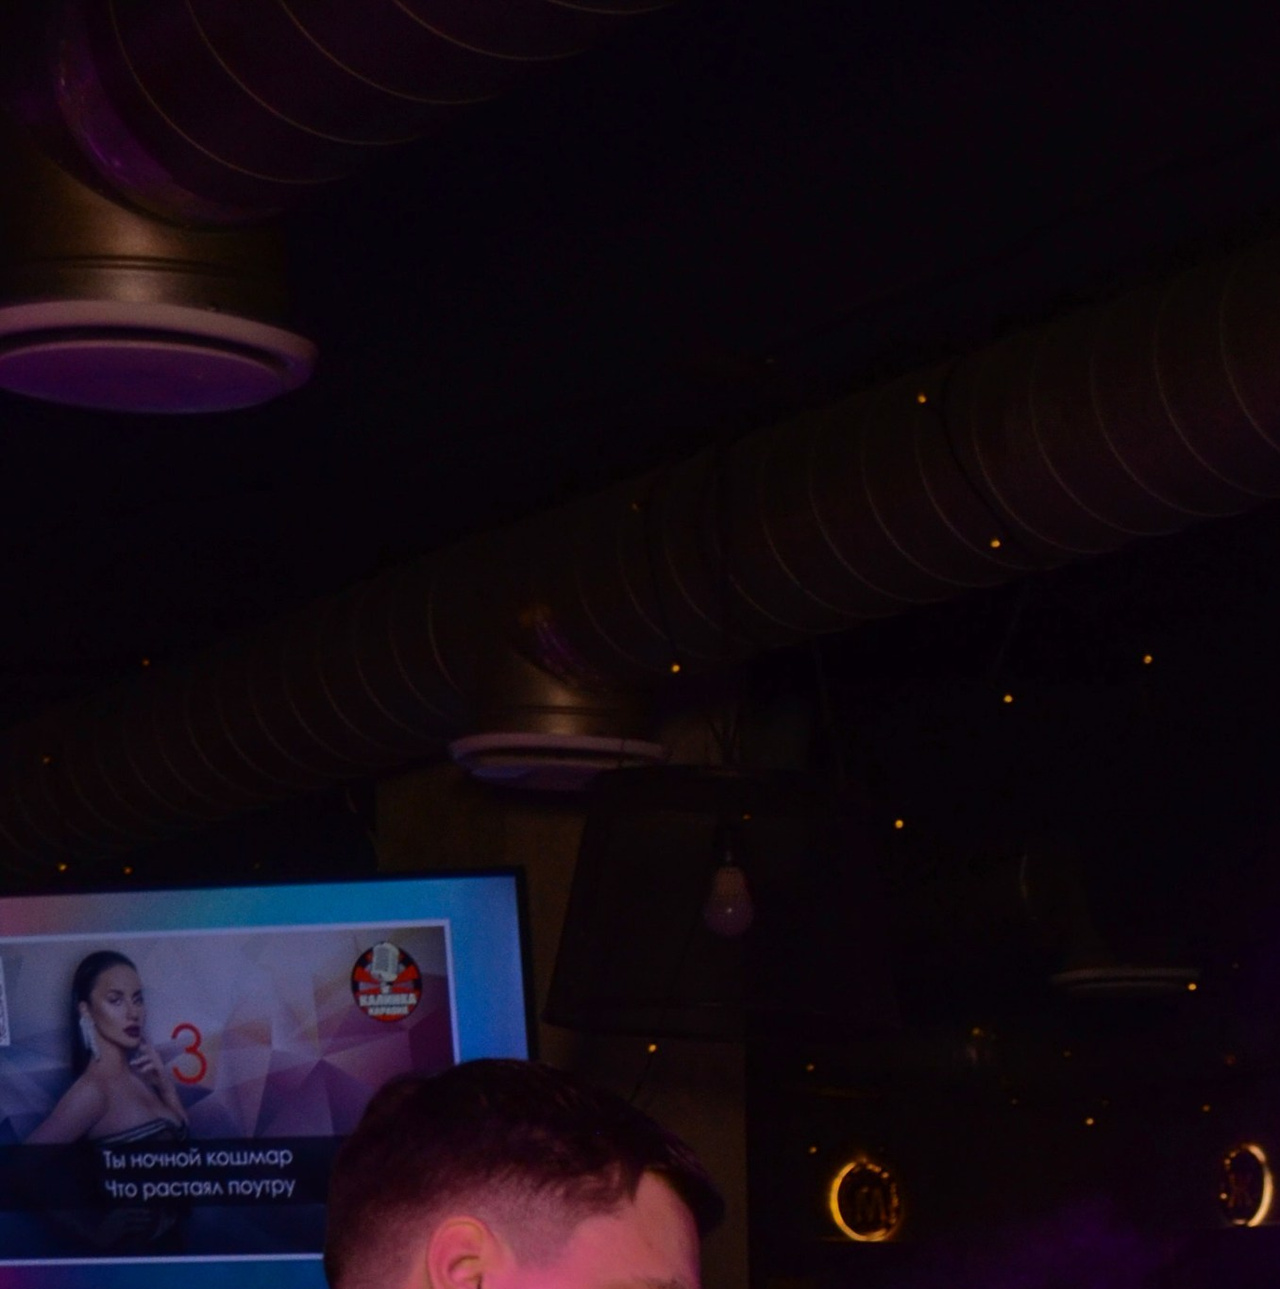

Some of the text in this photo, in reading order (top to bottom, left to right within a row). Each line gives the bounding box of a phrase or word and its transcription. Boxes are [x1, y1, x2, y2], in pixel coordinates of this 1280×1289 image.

[172, 1024, 206, 1083] 3
[102, 1148, 294, 1170] Ты ночной кошмар
[105, 1179, 296, 1201] Что растаял поутру
